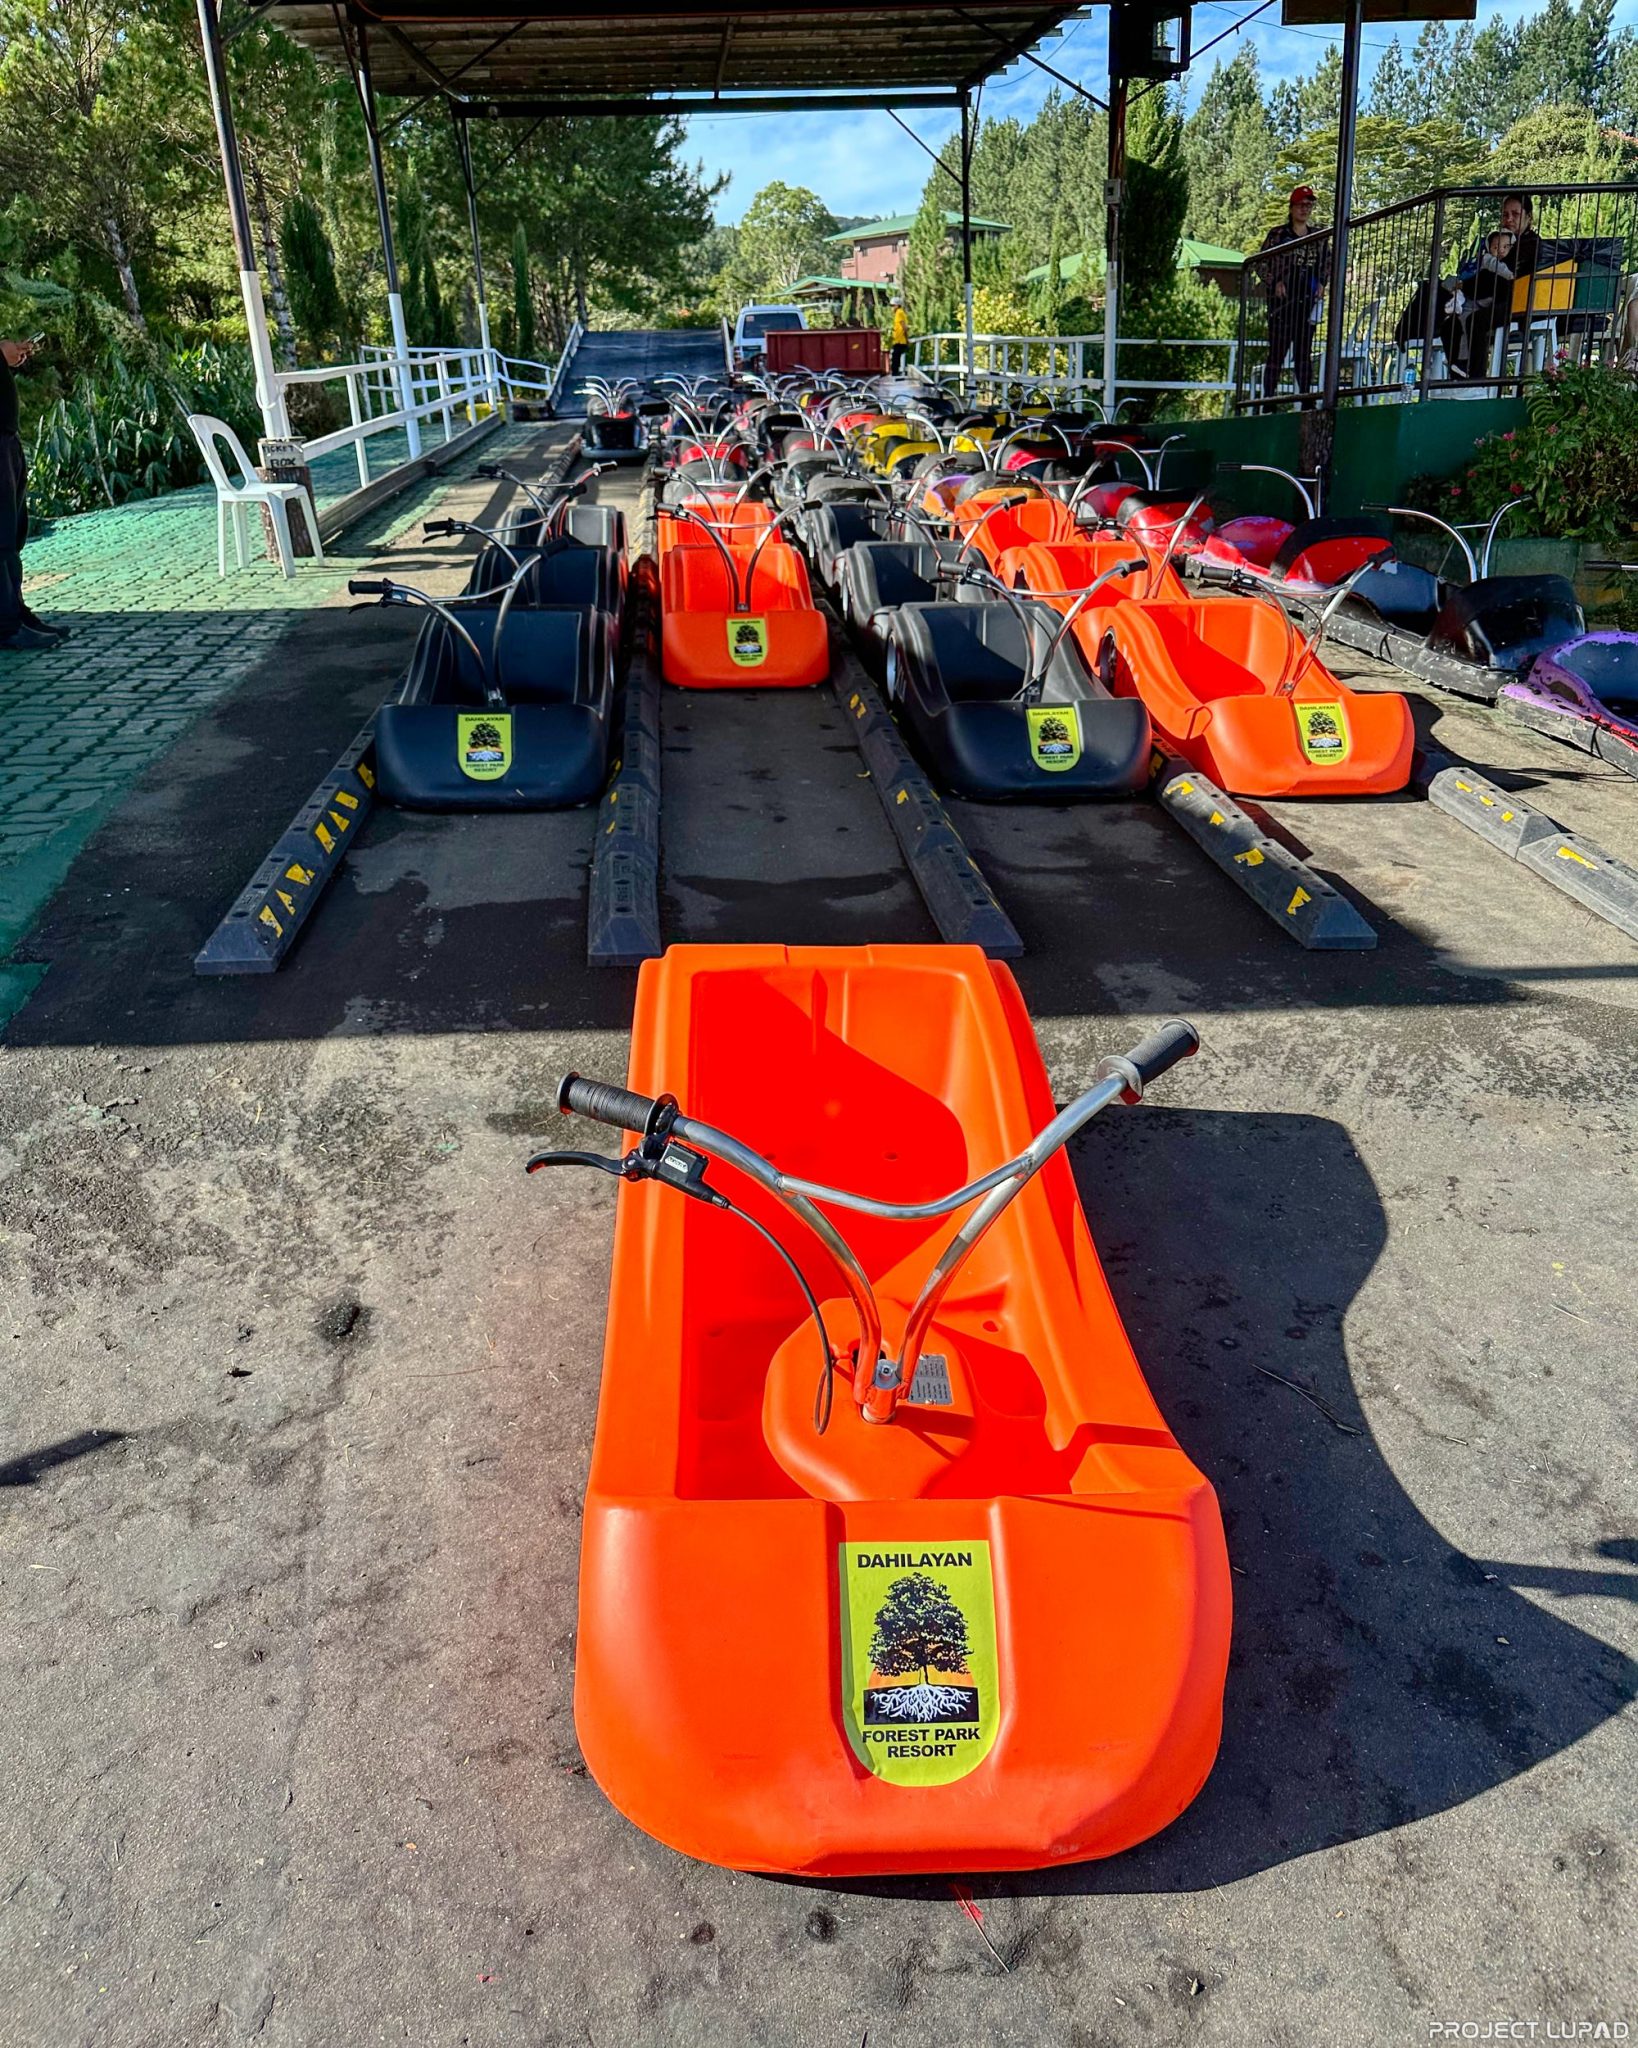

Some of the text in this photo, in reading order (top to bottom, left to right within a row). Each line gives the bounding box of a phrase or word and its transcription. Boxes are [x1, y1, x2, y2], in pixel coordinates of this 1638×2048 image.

[262, 445, 294, 453] TICKET
[270, 457, 296, 469] BOX
[857, 1552, 972, 1568] DAHILAYAN
[862, 1727, 981, 1743] FOREST PARK
[887, 1744, 957, 1758] RESORT
